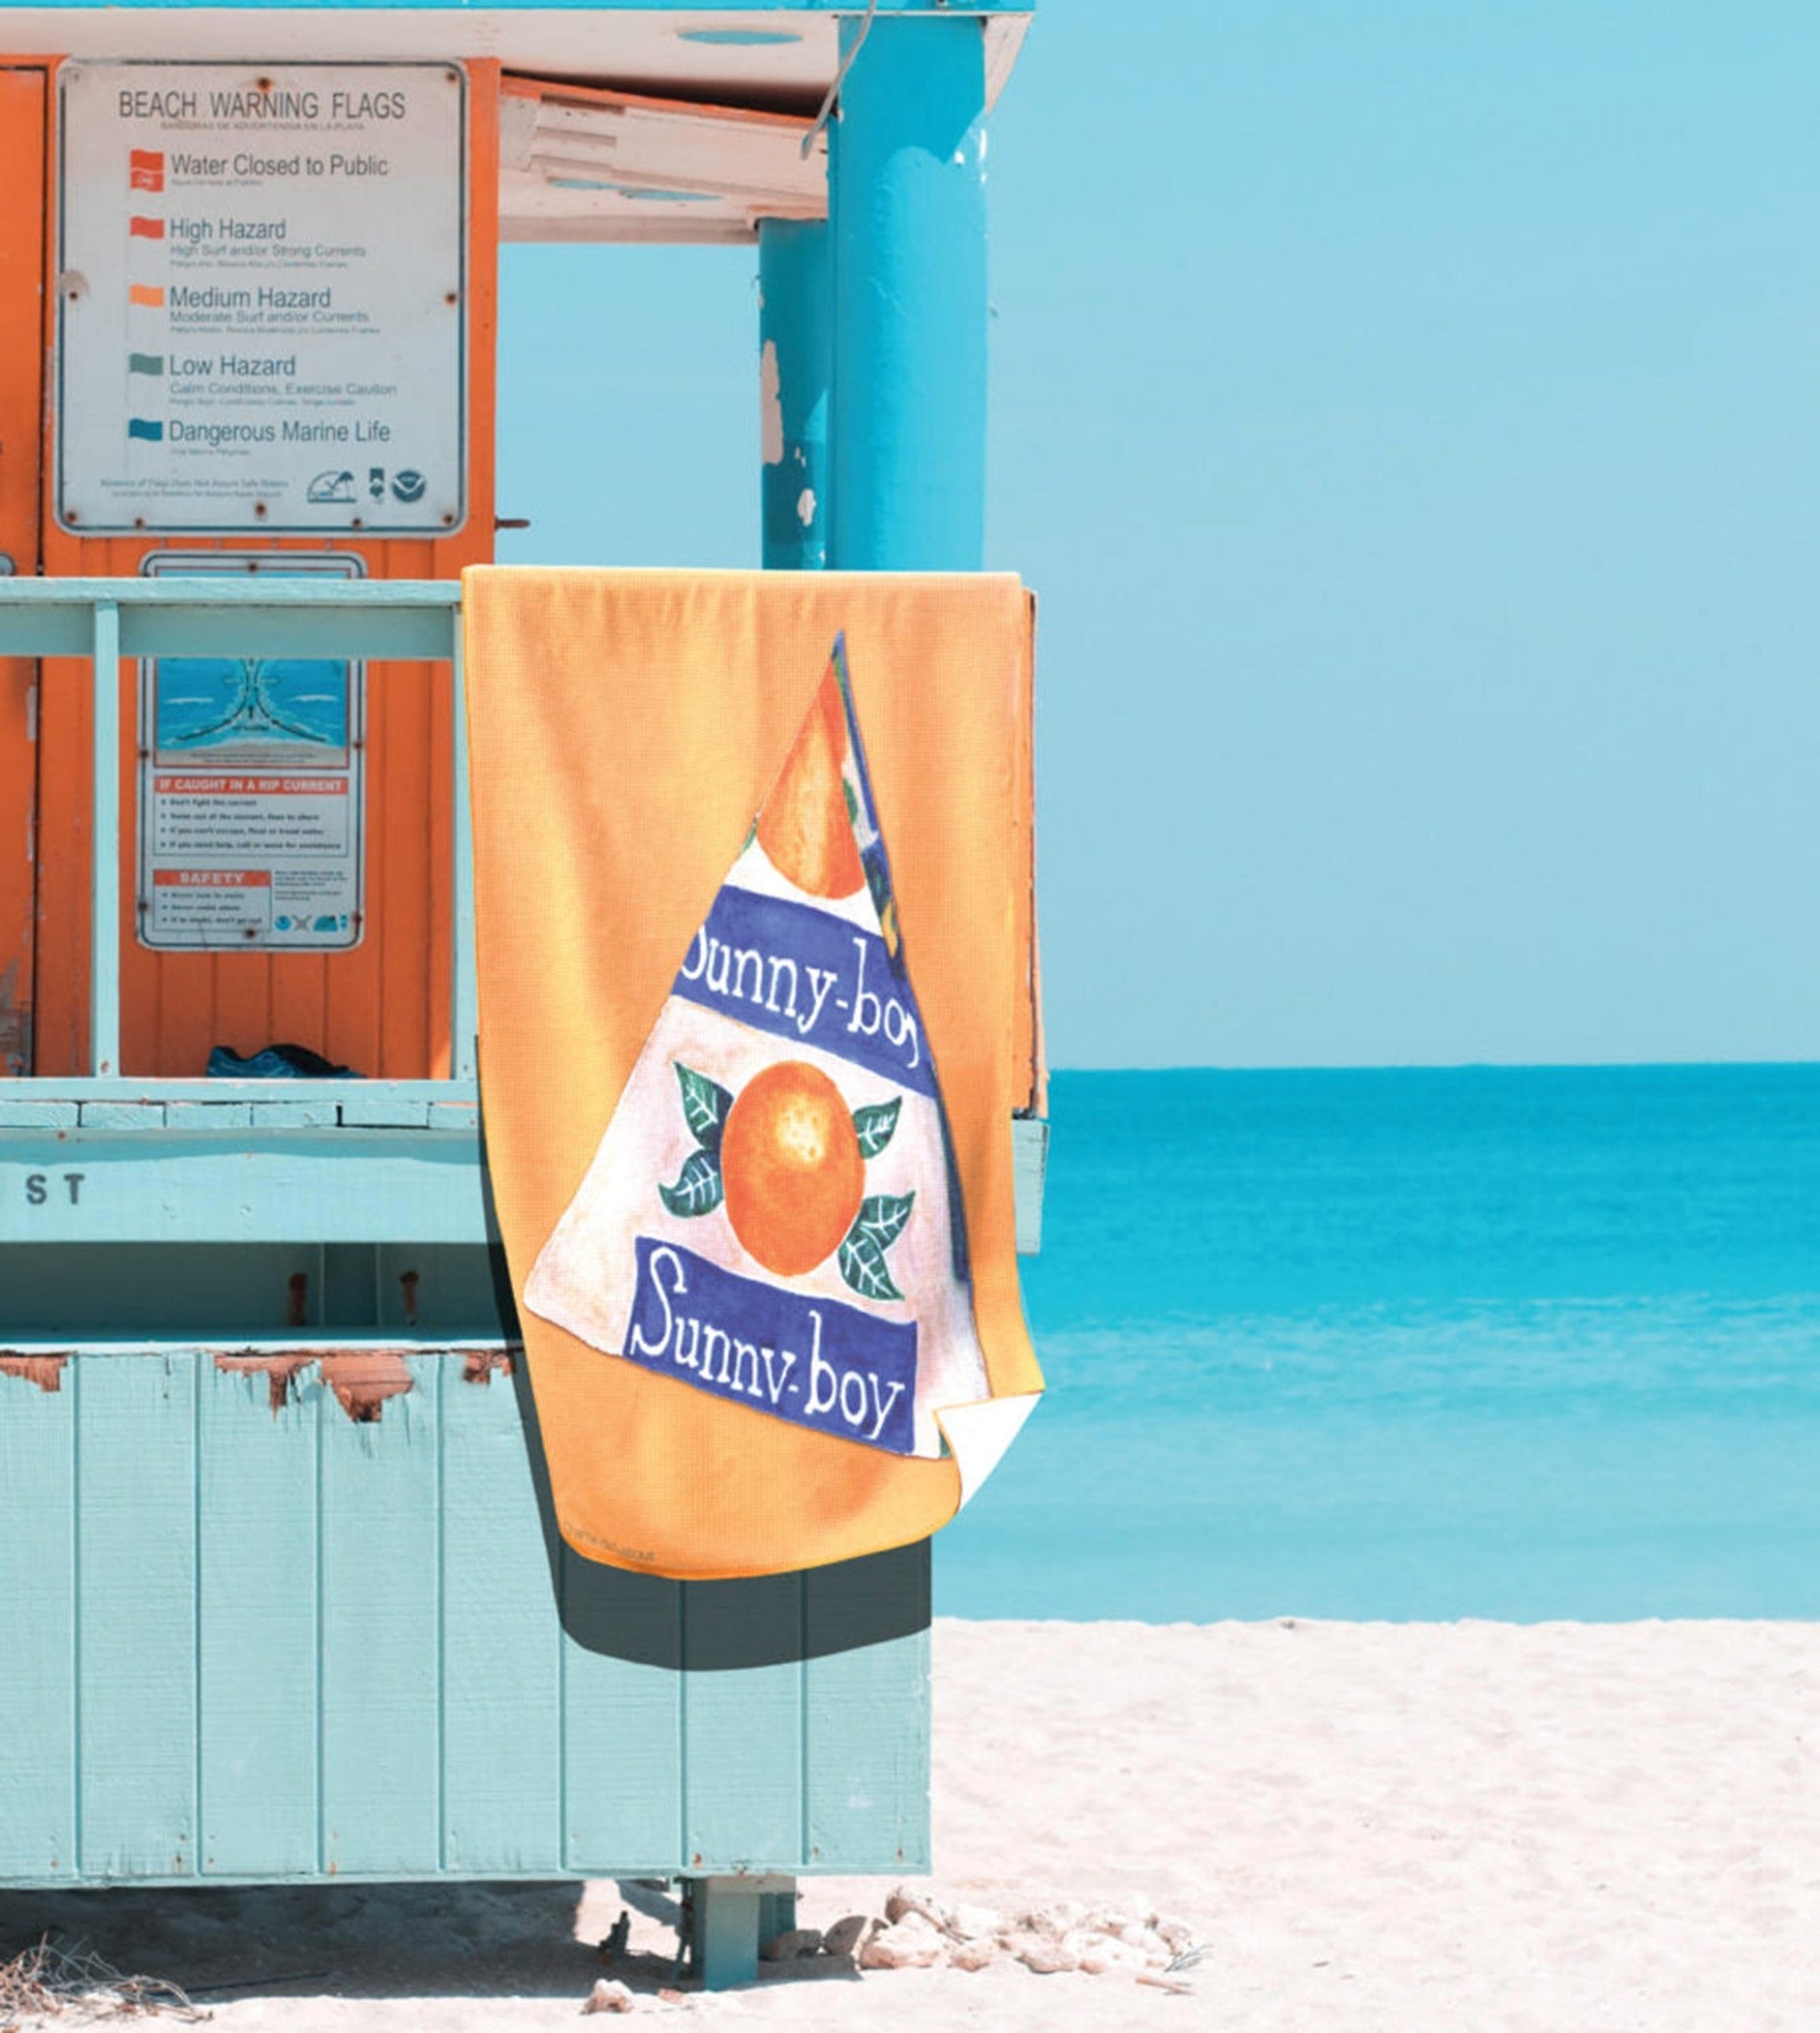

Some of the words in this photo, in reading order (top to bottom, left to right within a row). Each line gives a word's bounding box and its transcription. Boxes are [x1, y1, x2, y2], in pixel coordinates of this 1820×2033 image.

[119, 91, 197, 117] BEACH
[210, 92, 318, 119] WARNING
[332, 92, 406, 119] FLAGS
[171, 155, 228, 174] Water
[233, 154, 300, 175] Closed
[306, 157, 323, 175] to
[330, 154, 389, 175] Public
[170, 218, 213, 244] High
[220, 218, 287, 239] Hazard
[170, 287, 251, 307] Medium
[258, 287, 331, 308] Hazard
[170, 355, 213, 376] Low
[220, 355, 295, 376] Hazard
[170, 420, 276, 445] Dangerous
[283, 420, 349, 441] Marine
[356, 420, 390, 441] Life
[160, 778, 171, 791] IF
[174, 778, 226, 791] CAUGHT
[229, 778, 242, 791] IN
[246, 778, 256, 791] A
[258, 778, 280, 791] RIP
[283, 778, 343, 791] CURRENT
[180, 872, 245, 883] SAFETY
